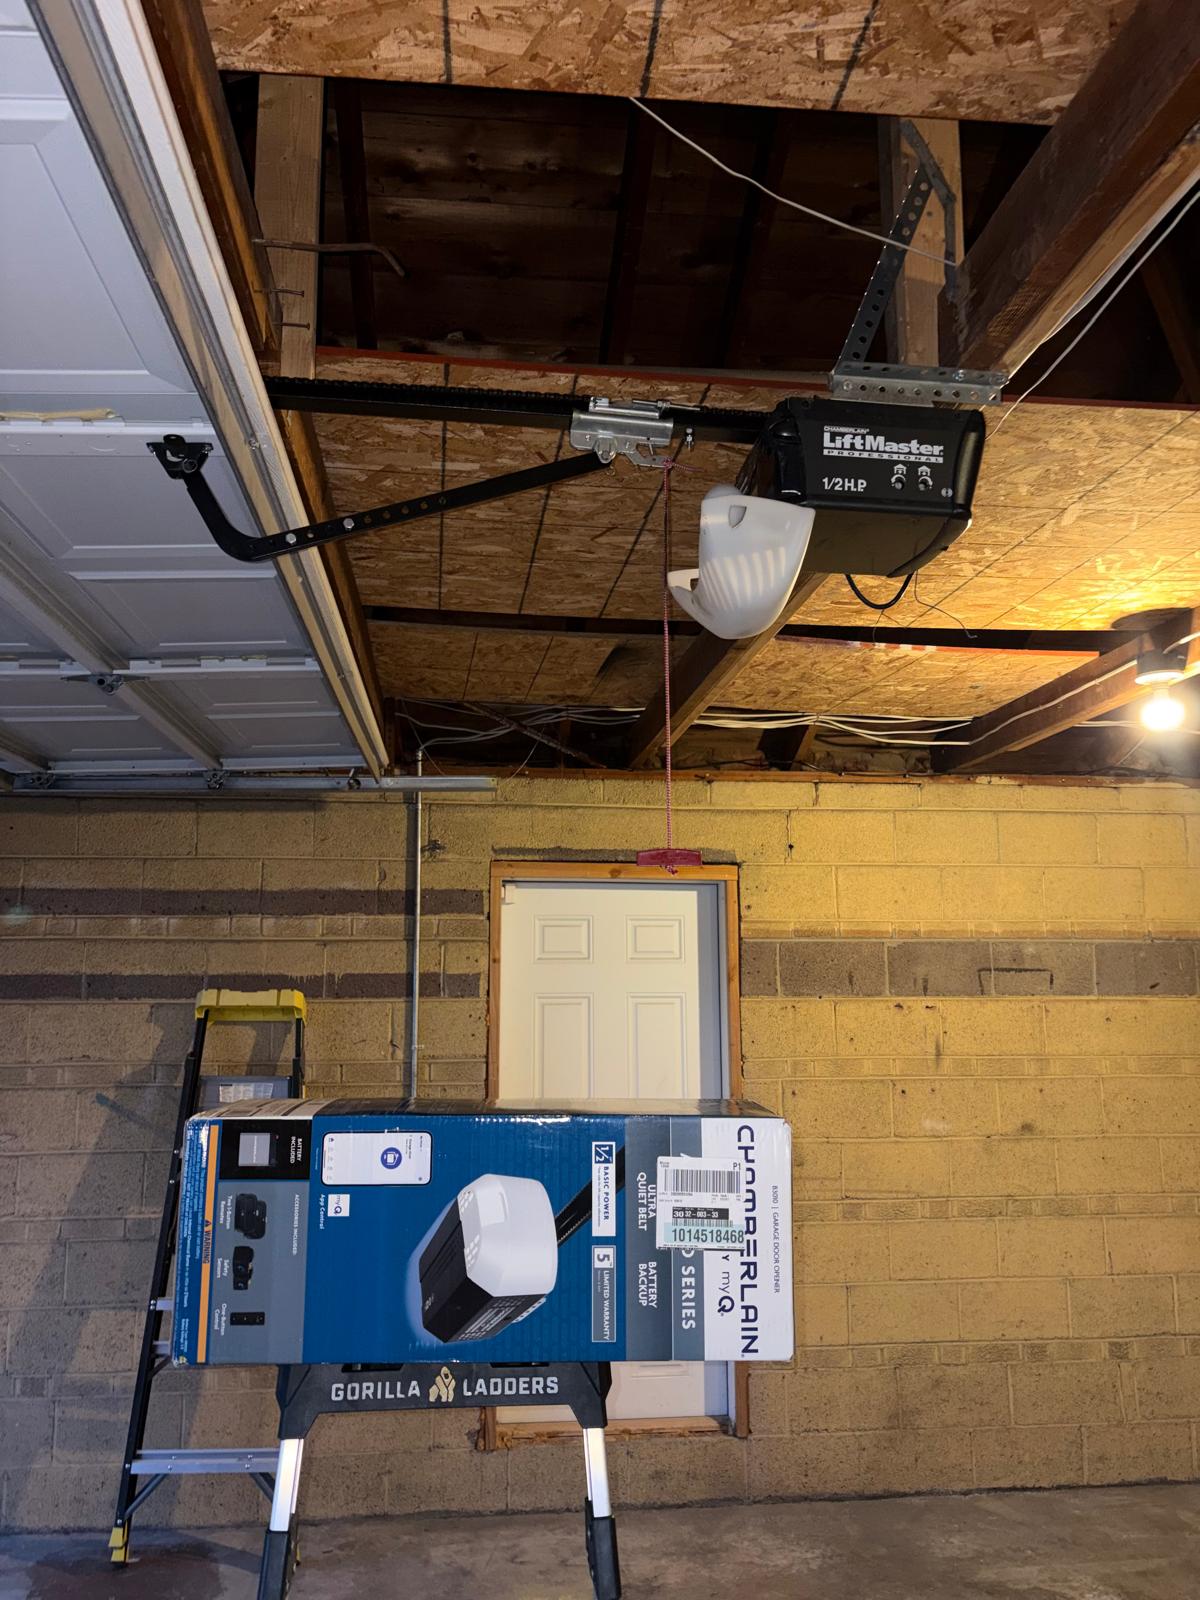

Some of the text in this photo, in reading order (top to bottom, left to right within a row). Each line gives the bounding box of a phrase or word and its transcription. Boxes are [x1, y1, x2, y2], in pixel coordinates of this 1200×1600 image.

[823, 431, 944, 456] LiftMaster
[826, 449, 942, 463] PROFESSIONAL
[732, 1162, 742, 1170] P1
[637, 1172, 648, 1231] QUIET BELT
[647, 1184, 657, 1218] ULTRA
[203, 1230, 212, 1264] WARNING
[671, 1227, 745, 1243] 1014518468
[222, 1259, 230, 1277] Safety
[596, 1253, 610, 1263] 5
[638, 1263, 648, 1307] BACKUP
[648, 1261, 658, 1309] BATTERY
[681, 1265, 696, 1330] SERIES
[220, 1303, 228, 1336] One-Button
[602, 1270, 610, 1340] LIMITED WARRANTY
[330, 1376, 559, 1402] GORILLA LADDERS
